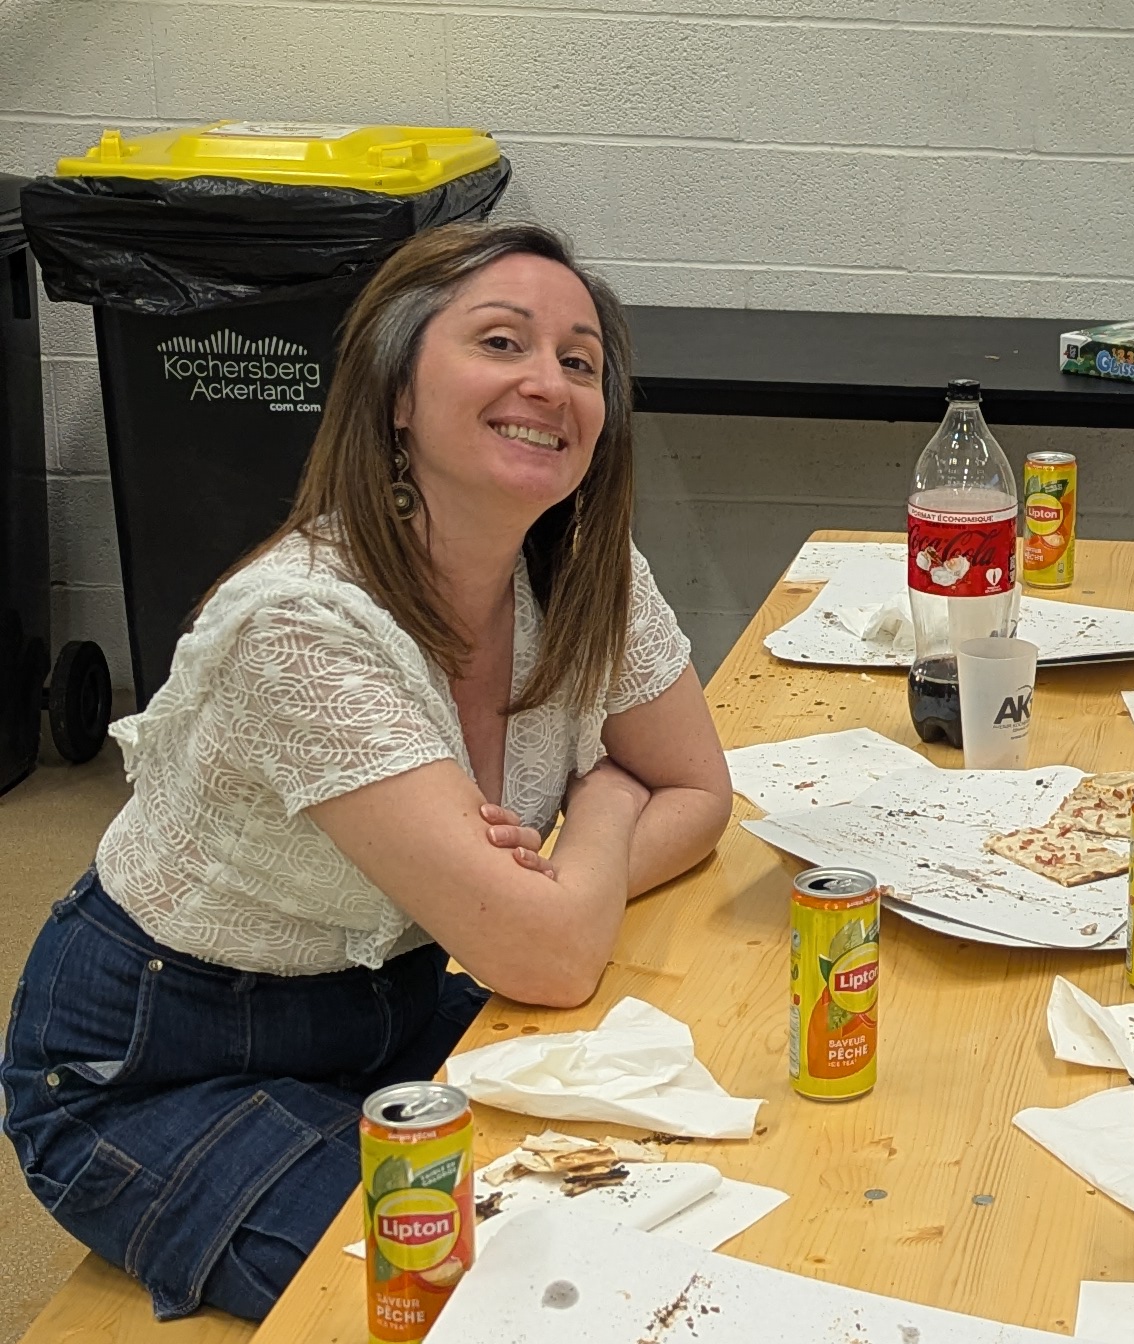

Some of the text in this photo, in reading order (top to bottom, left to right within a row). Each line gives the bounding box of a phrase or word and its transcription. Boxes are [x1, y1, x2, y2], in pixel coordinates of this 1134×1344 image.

[164, 355, 320, 388] Kochersberg
[190, 378, 304, 402] Ackerland
[269, 403, 321, 412] com com
[911, 508, 994, 524] FORMAT ÉCONOMIQUE
[1028, 507, 1058, 519] Lipton
[993, 694, 1032, 725] AK
[840, 966, 879, 990] Lipton
[828, 1035, 866, 1047] SAVEUR
[828, 1044, 869, 1061] PÊCHE
[381, 1217, 450, 1241] Lipton
[376, 1292, 421, 1309] SAVEUR
[376, 1305, 426, 1324] PÊCHE
